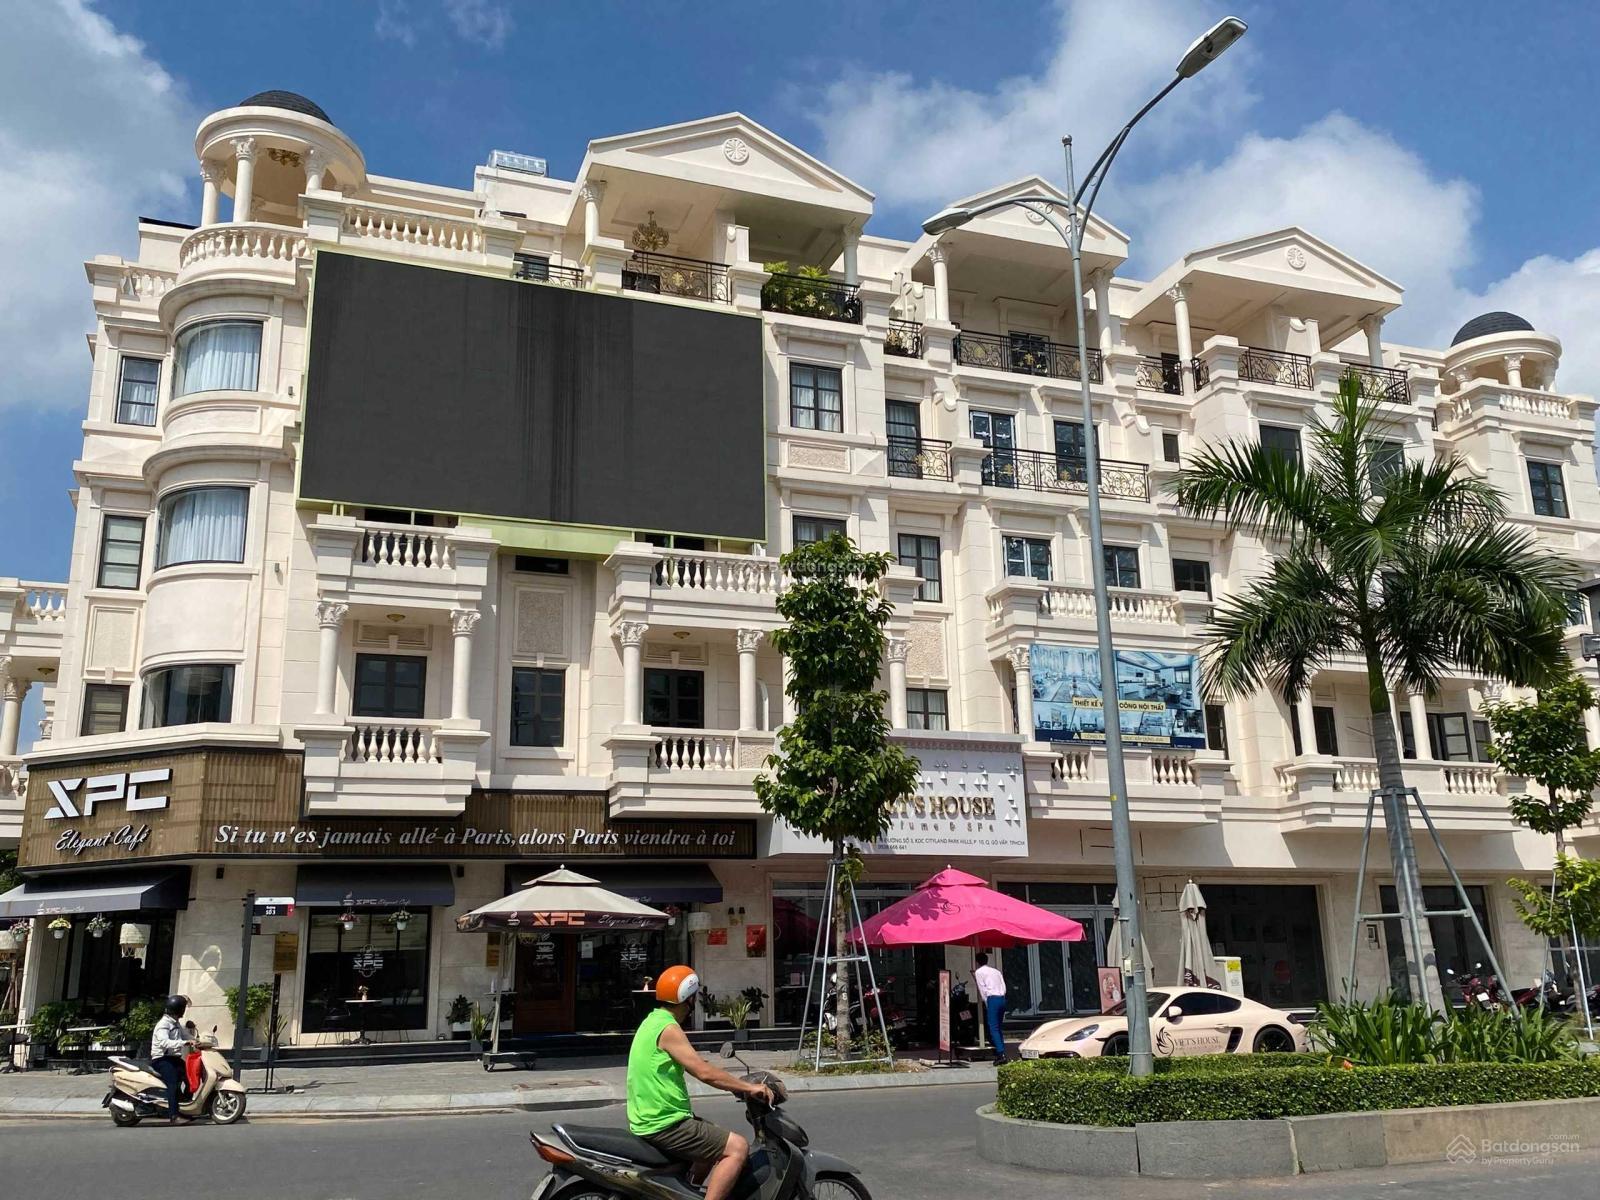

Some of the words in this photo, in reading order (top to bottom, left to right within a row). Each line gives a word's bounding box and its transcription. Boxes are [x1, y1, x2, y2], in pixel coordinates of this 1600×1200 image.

[1119, 701, 1137, 709] CÔNG
[43, 768, 171, 819] XPC
[929, 796, 995, 816] HOUSE
[55, 829, 112, 855] Elegant
[113, 824, 149, 850] Café
[214, 825, 239, 843] Si
[245, 826, 266, 843] tu
[272, 826, 317, 843] n'es
[318, 826, 393, 849] jamais
[400, 827, 437, 844] allé
[443, 828, 456, 844] à
[518, 828, 566, 845] alors
[570, 828, 619, 845] Paris
[624, 829, 692, 845] viendra
[696, 830, 707, 845] à
[712, 830, 736, 846] toi
[532, 912, 586, 926] XPC
[353, 959, 384, 967] XPC
